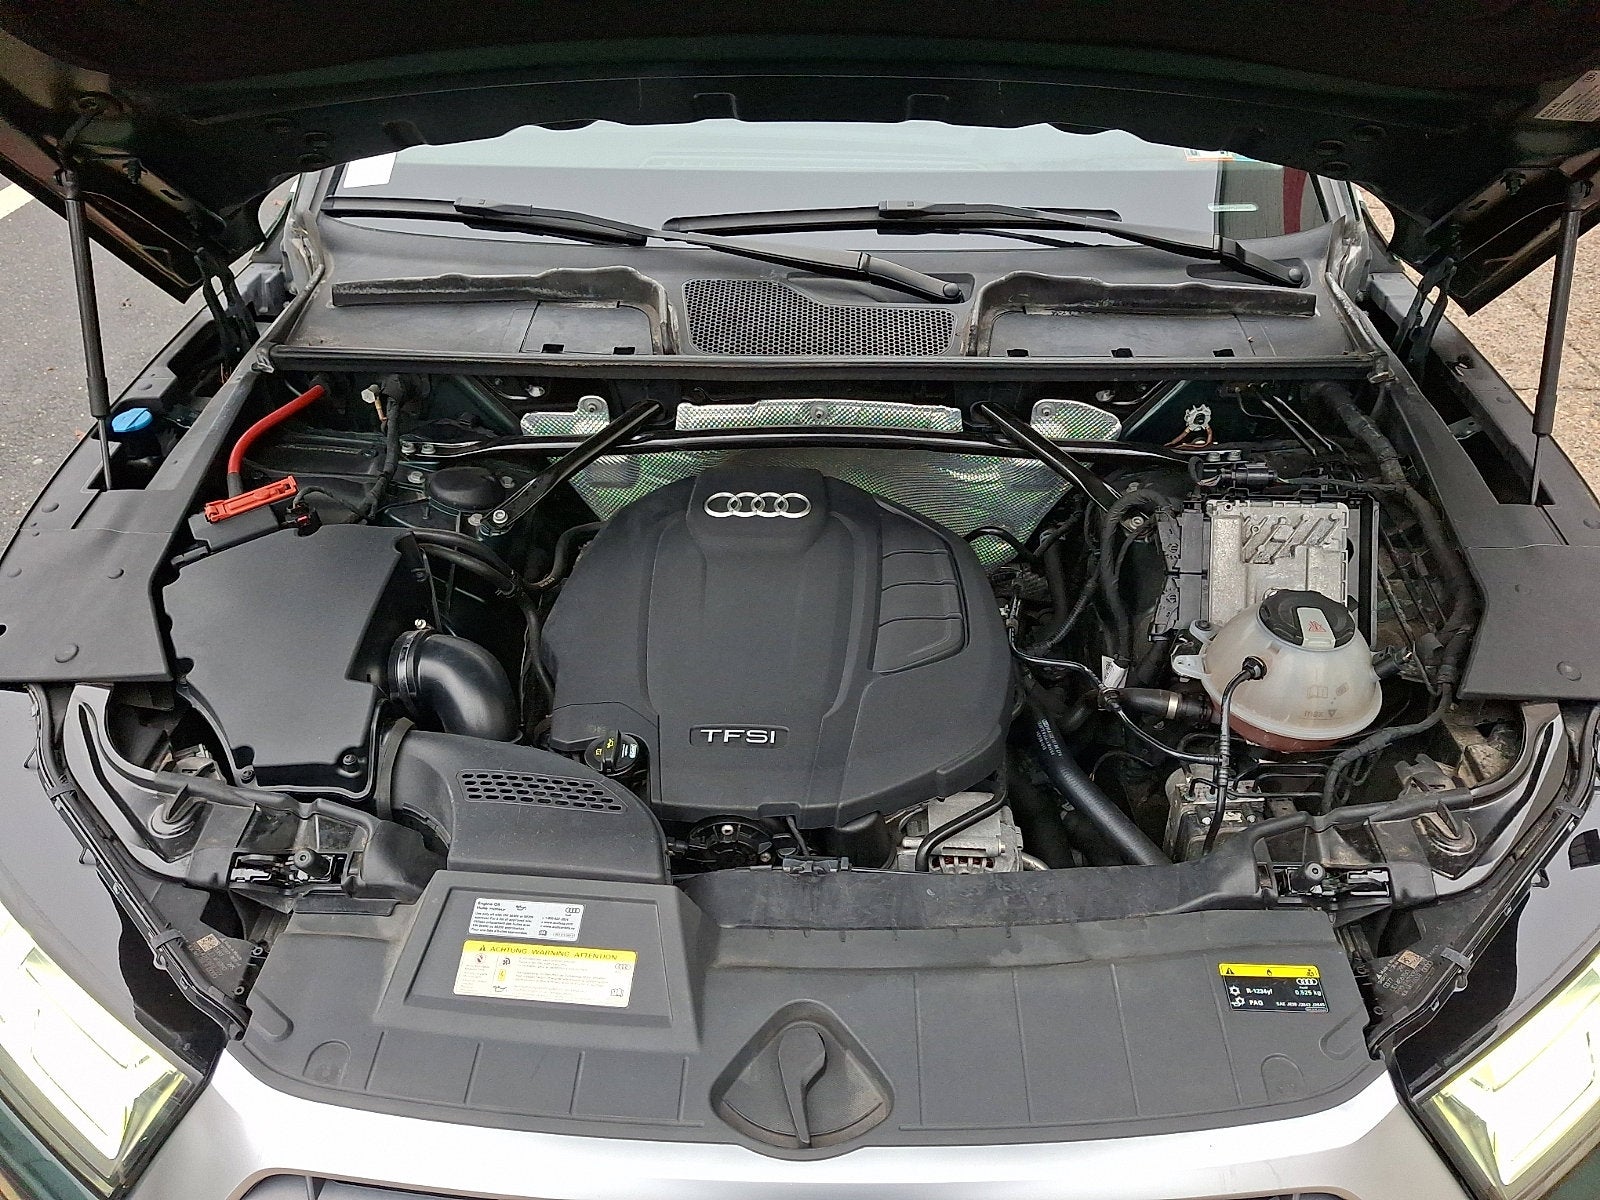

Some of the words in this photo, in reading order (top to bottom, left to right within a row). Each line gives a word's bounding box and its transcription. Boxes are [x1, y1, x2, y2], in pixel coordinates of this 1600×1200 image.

[700, 729, 776, 744] TFSI
[490, 946, 527, 955] ACHTUNG
[531, 949, 570, 958] WARNING
[574, 952, 618, 960] ATTENTION
